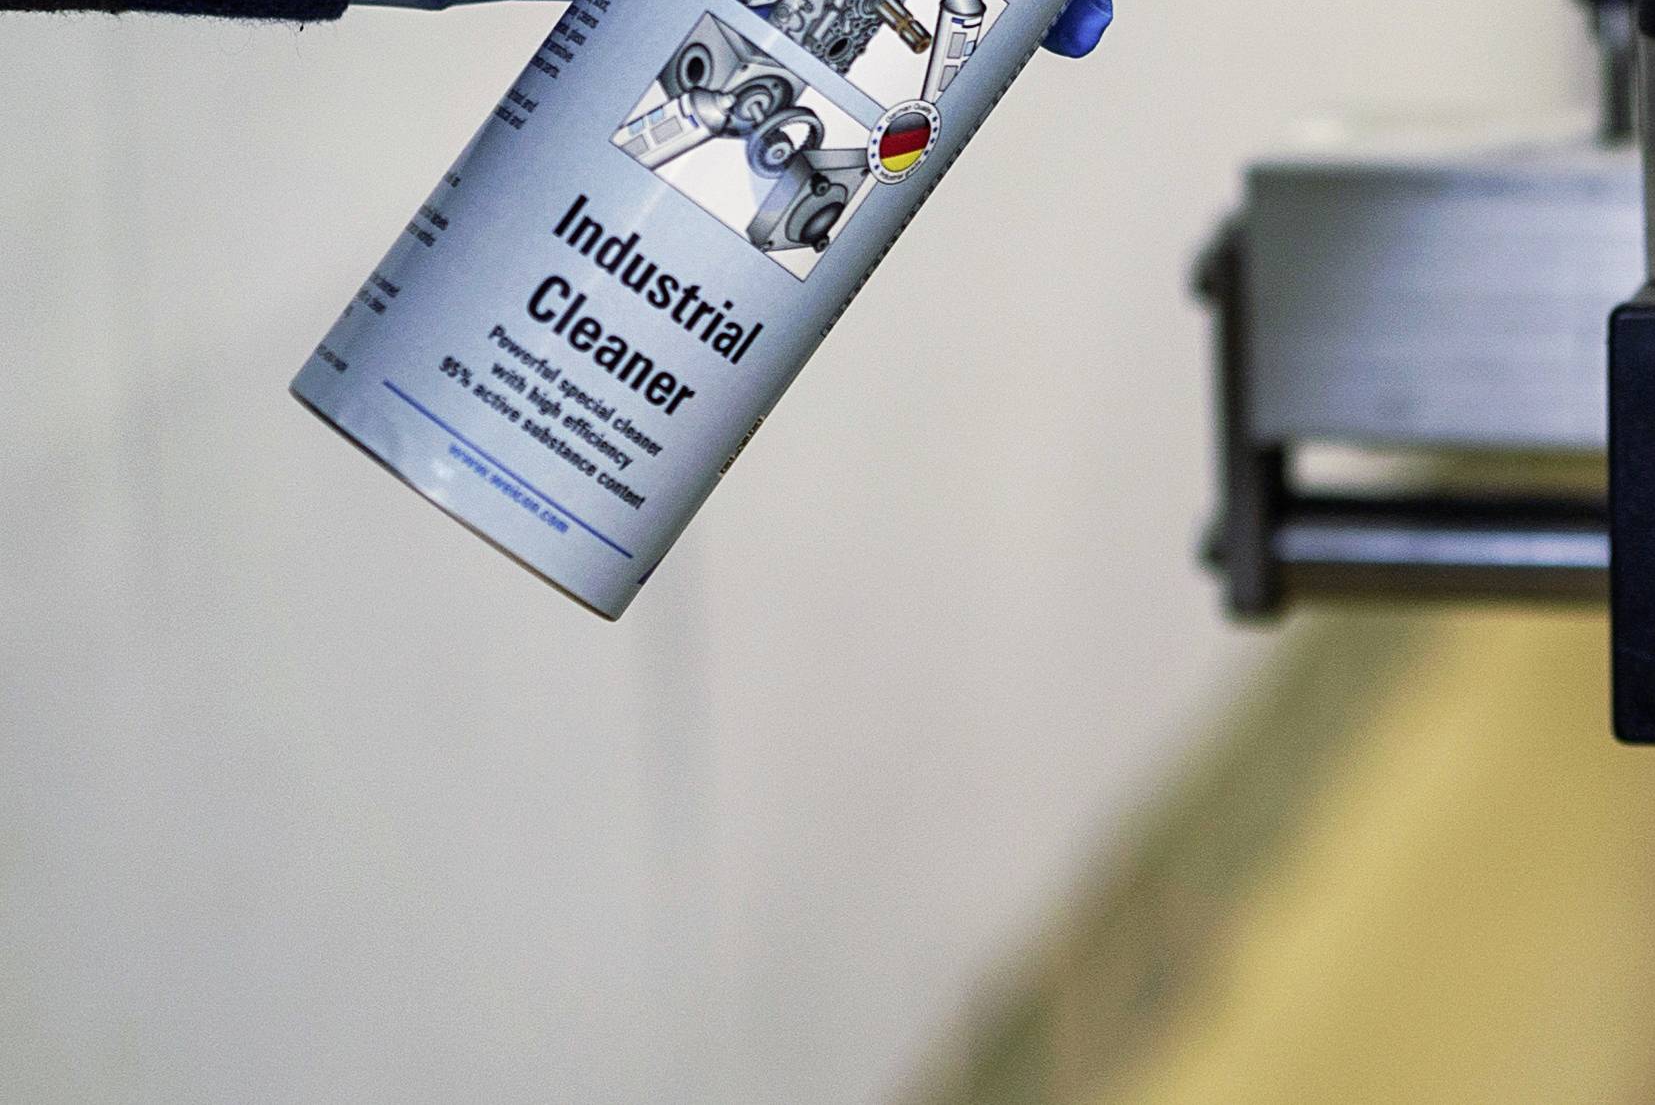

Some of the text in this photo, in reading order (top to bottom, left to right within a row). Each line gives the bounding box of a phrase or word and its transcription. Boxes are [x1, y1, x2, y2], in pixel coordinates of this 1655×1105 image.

[528, 276, 695, 415] Cleaner
[553, 195, 763, 364] Industrial
[440, 356, 645, 510] 95% active substance content
[489, 325, 662, 456] Powerful special cleaner
[492, 363, 633, 470] with high efficiency
